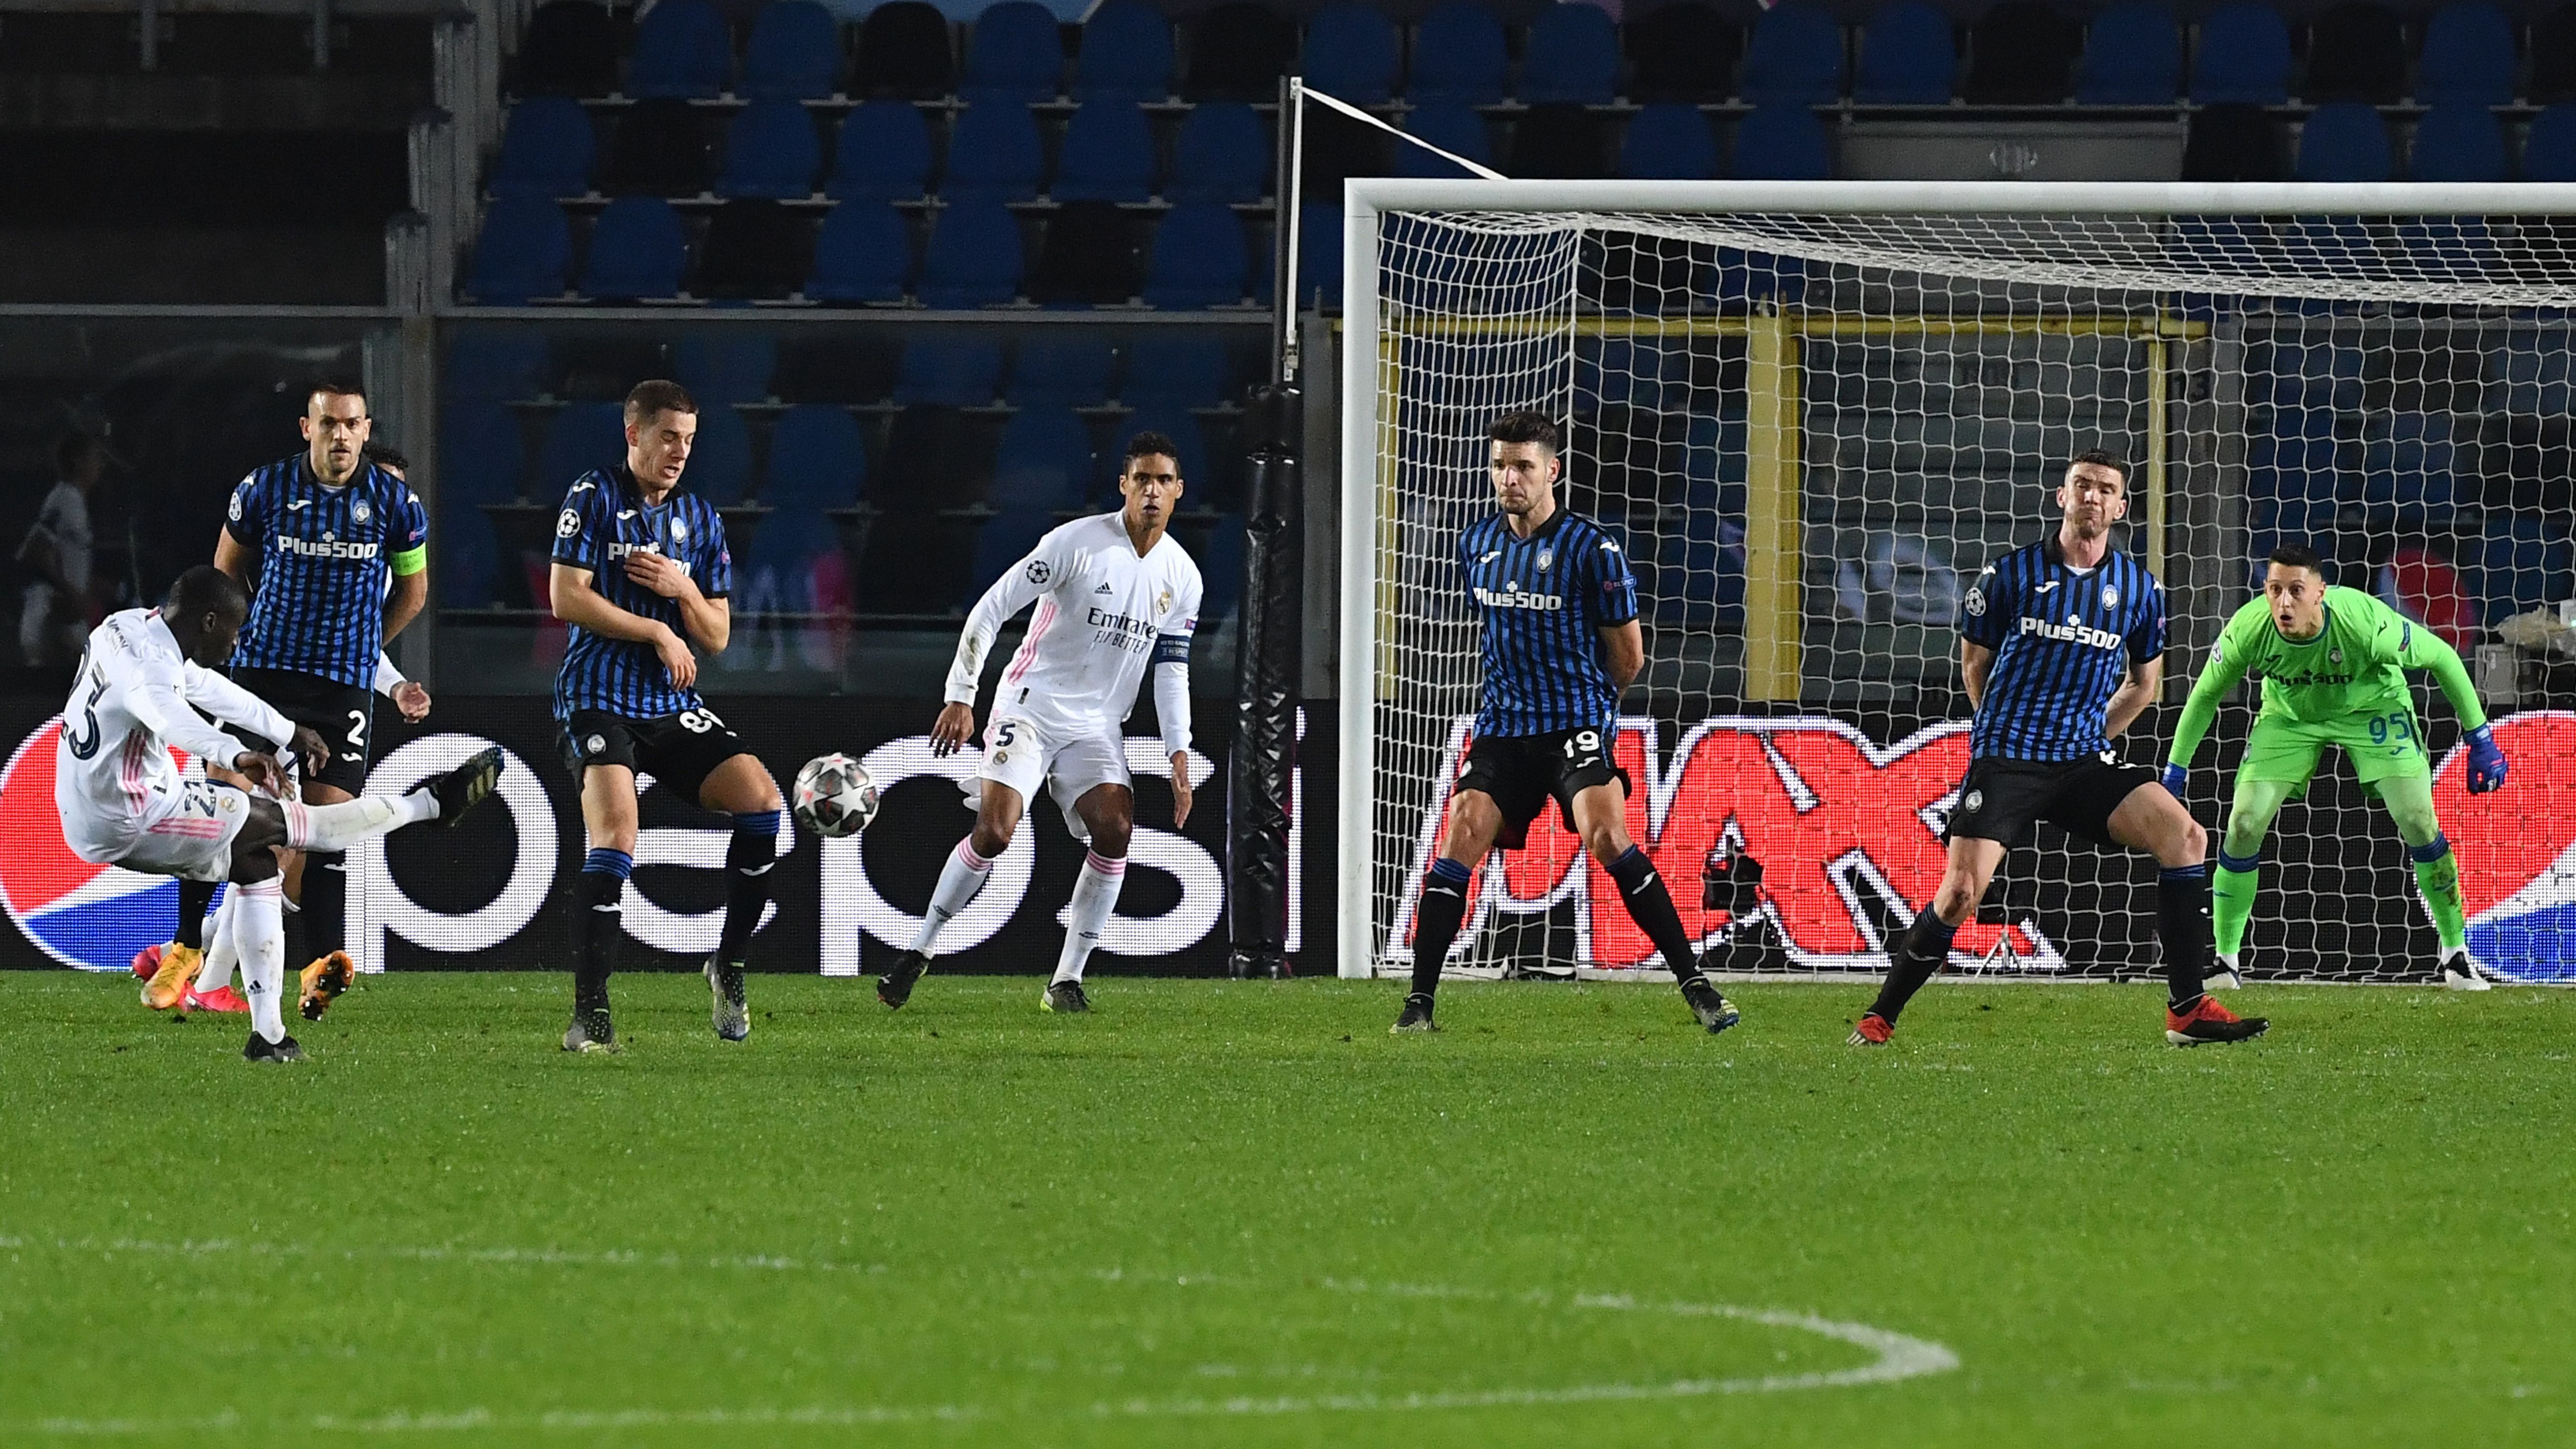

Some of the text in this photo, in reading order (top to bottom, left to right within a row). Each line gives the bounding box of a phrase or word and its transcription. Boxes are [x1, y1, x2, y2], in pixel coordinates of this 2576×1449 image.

[278, 535, 378, 559] Plus500
[1473, 588, 1562, 610] Plus500
[1111, 633, 1148, 654] BETTER
[2021, 616, 2121, 650] Plus500
[347, 710, 366, 746] 2
[995, 723, 1016, 747] 5
[2369, 712, 2410, 744] 95
[1563, 731, 1599, 758] 19
